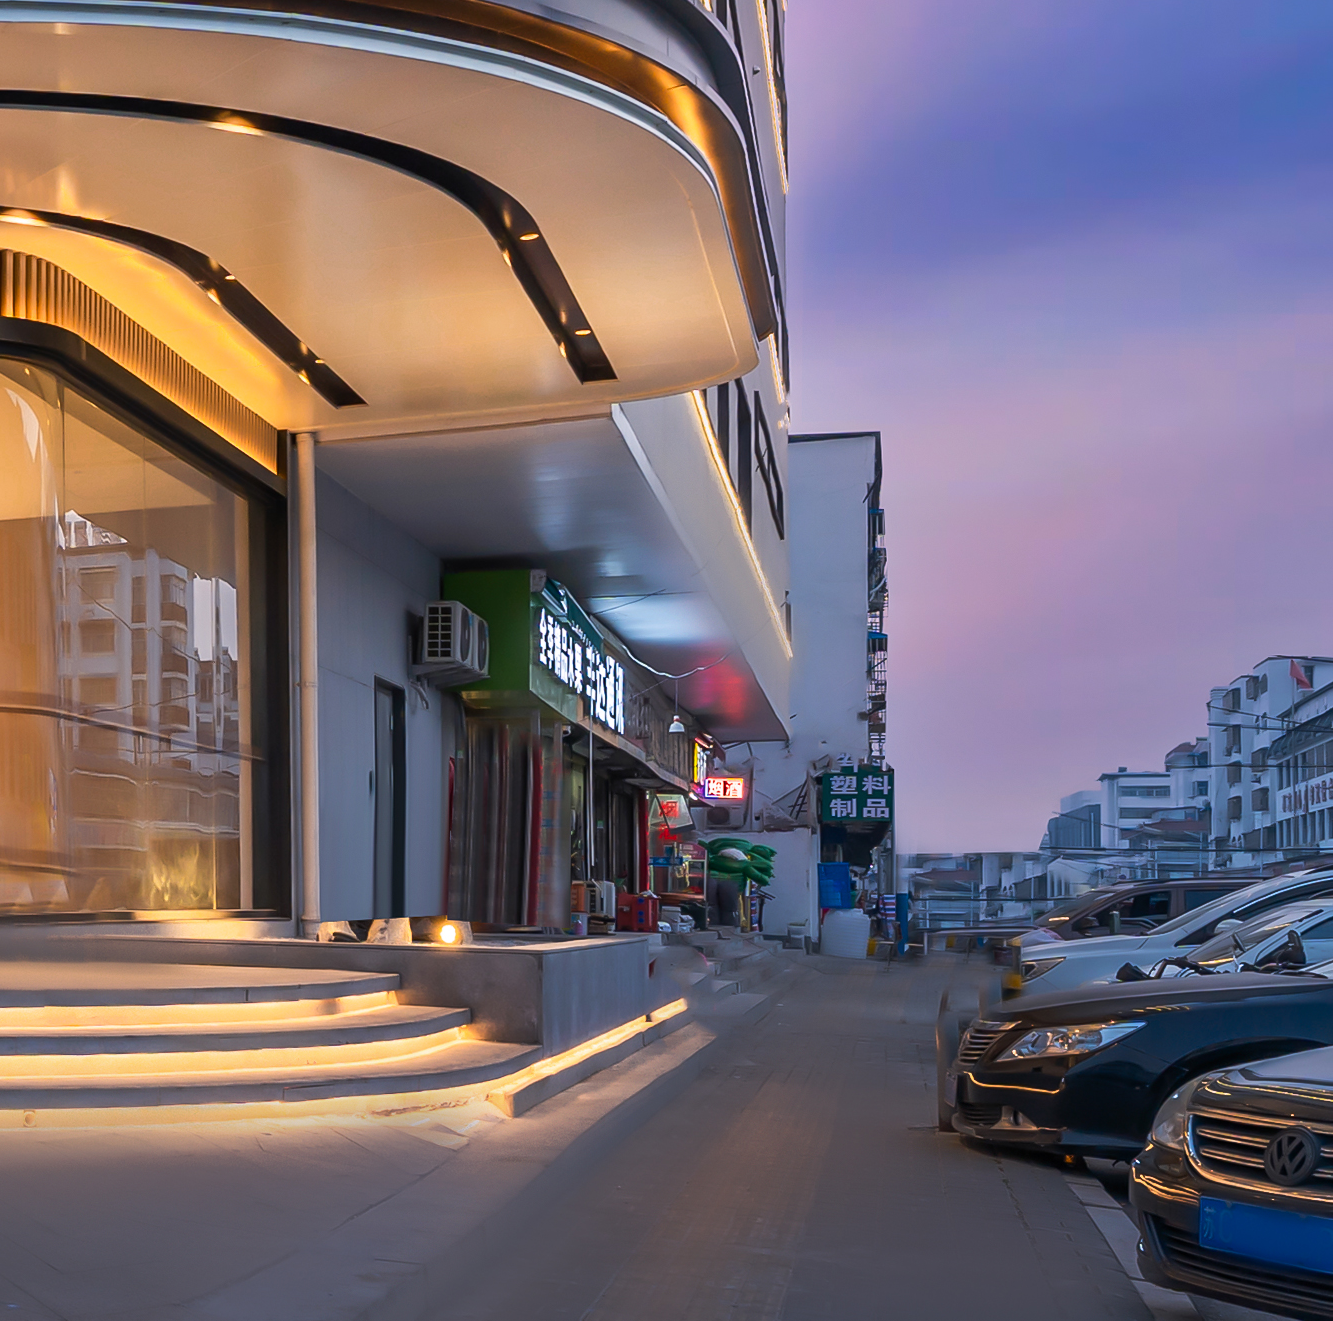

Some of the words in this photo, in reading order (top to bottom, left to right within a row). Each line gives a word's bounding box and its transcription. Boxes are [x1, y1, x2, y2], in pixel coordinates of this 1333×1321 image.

[707, 779, 742, 797] 烟酒
[829, 774, 892, 795] 塑料
[829, 797, 890, 818] 制品
